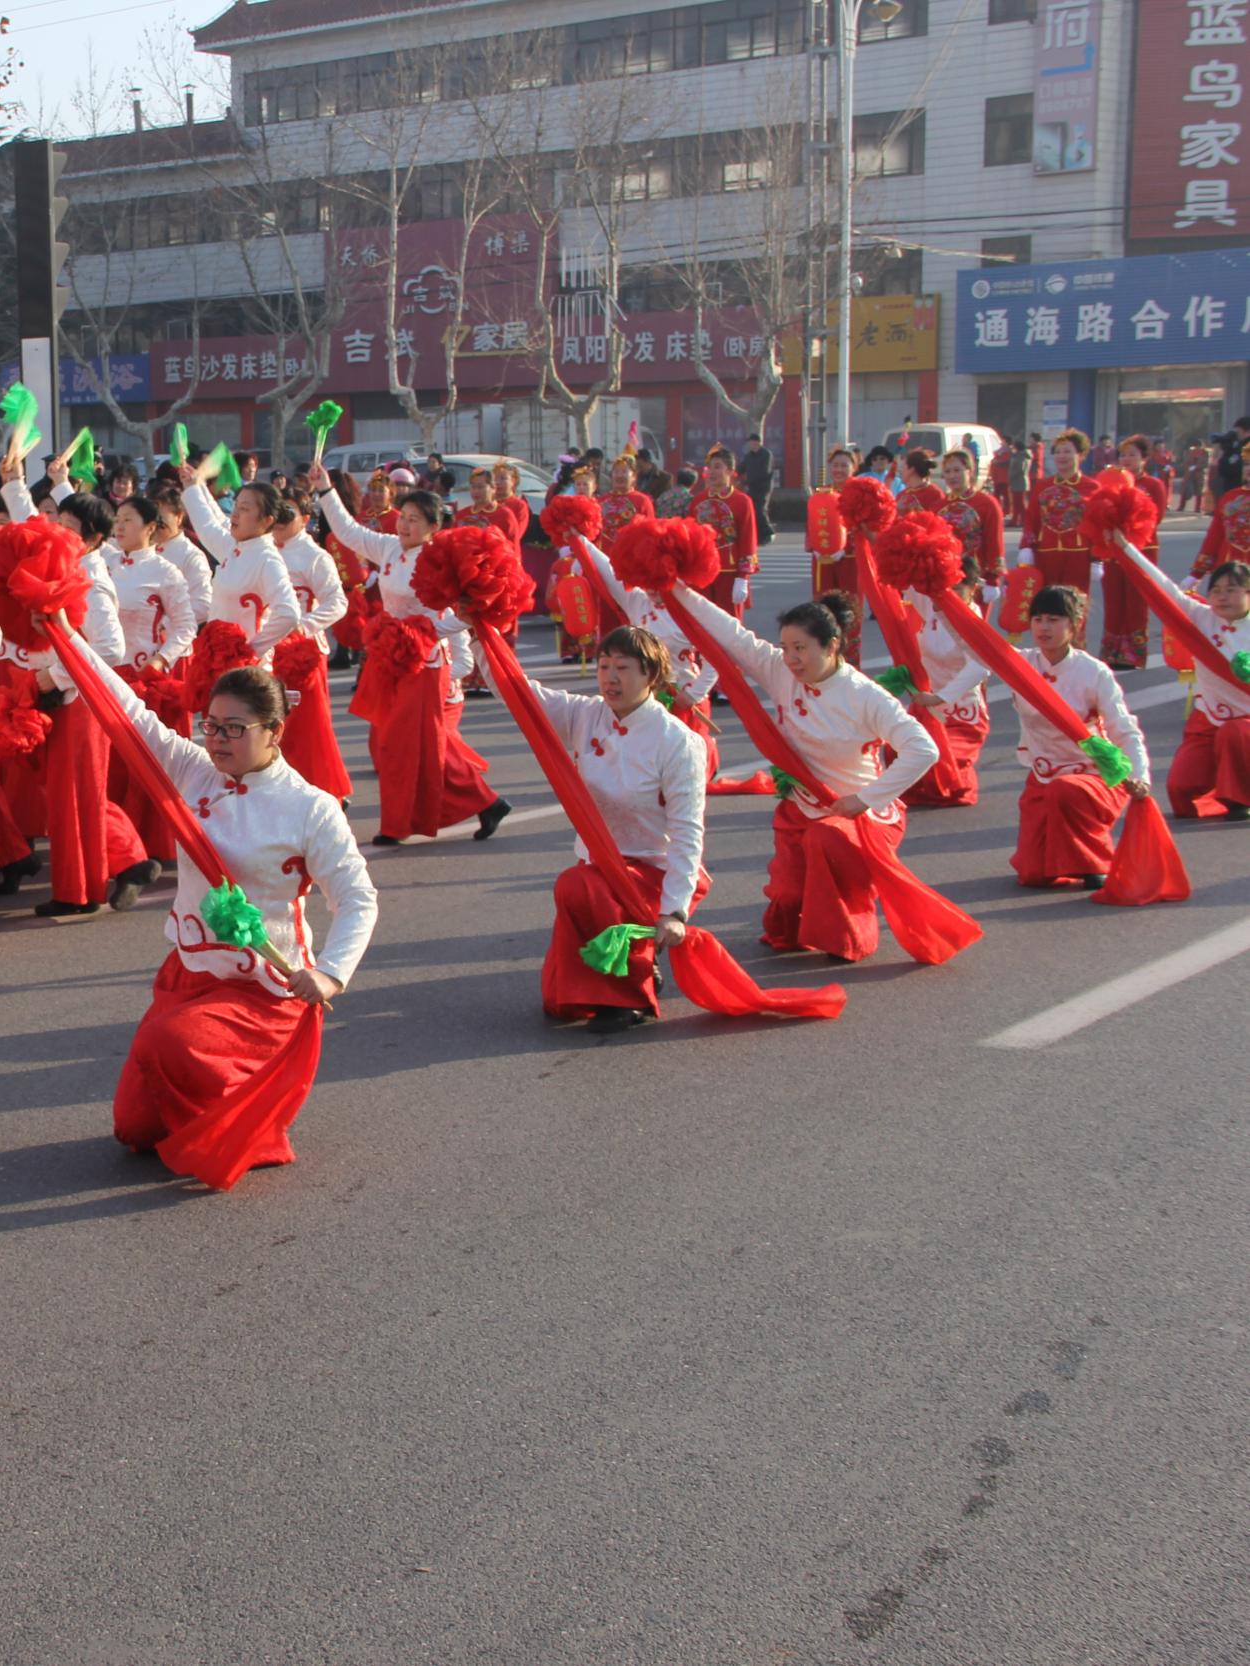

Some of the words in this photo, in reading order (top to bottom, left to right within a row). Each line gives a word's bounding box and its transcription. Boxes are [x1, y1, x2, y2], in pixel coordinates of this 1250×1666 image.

[1173, 0, 1249, 229] 蓝鸟家具
[974, 295, 1250, 346] 通海路合作
